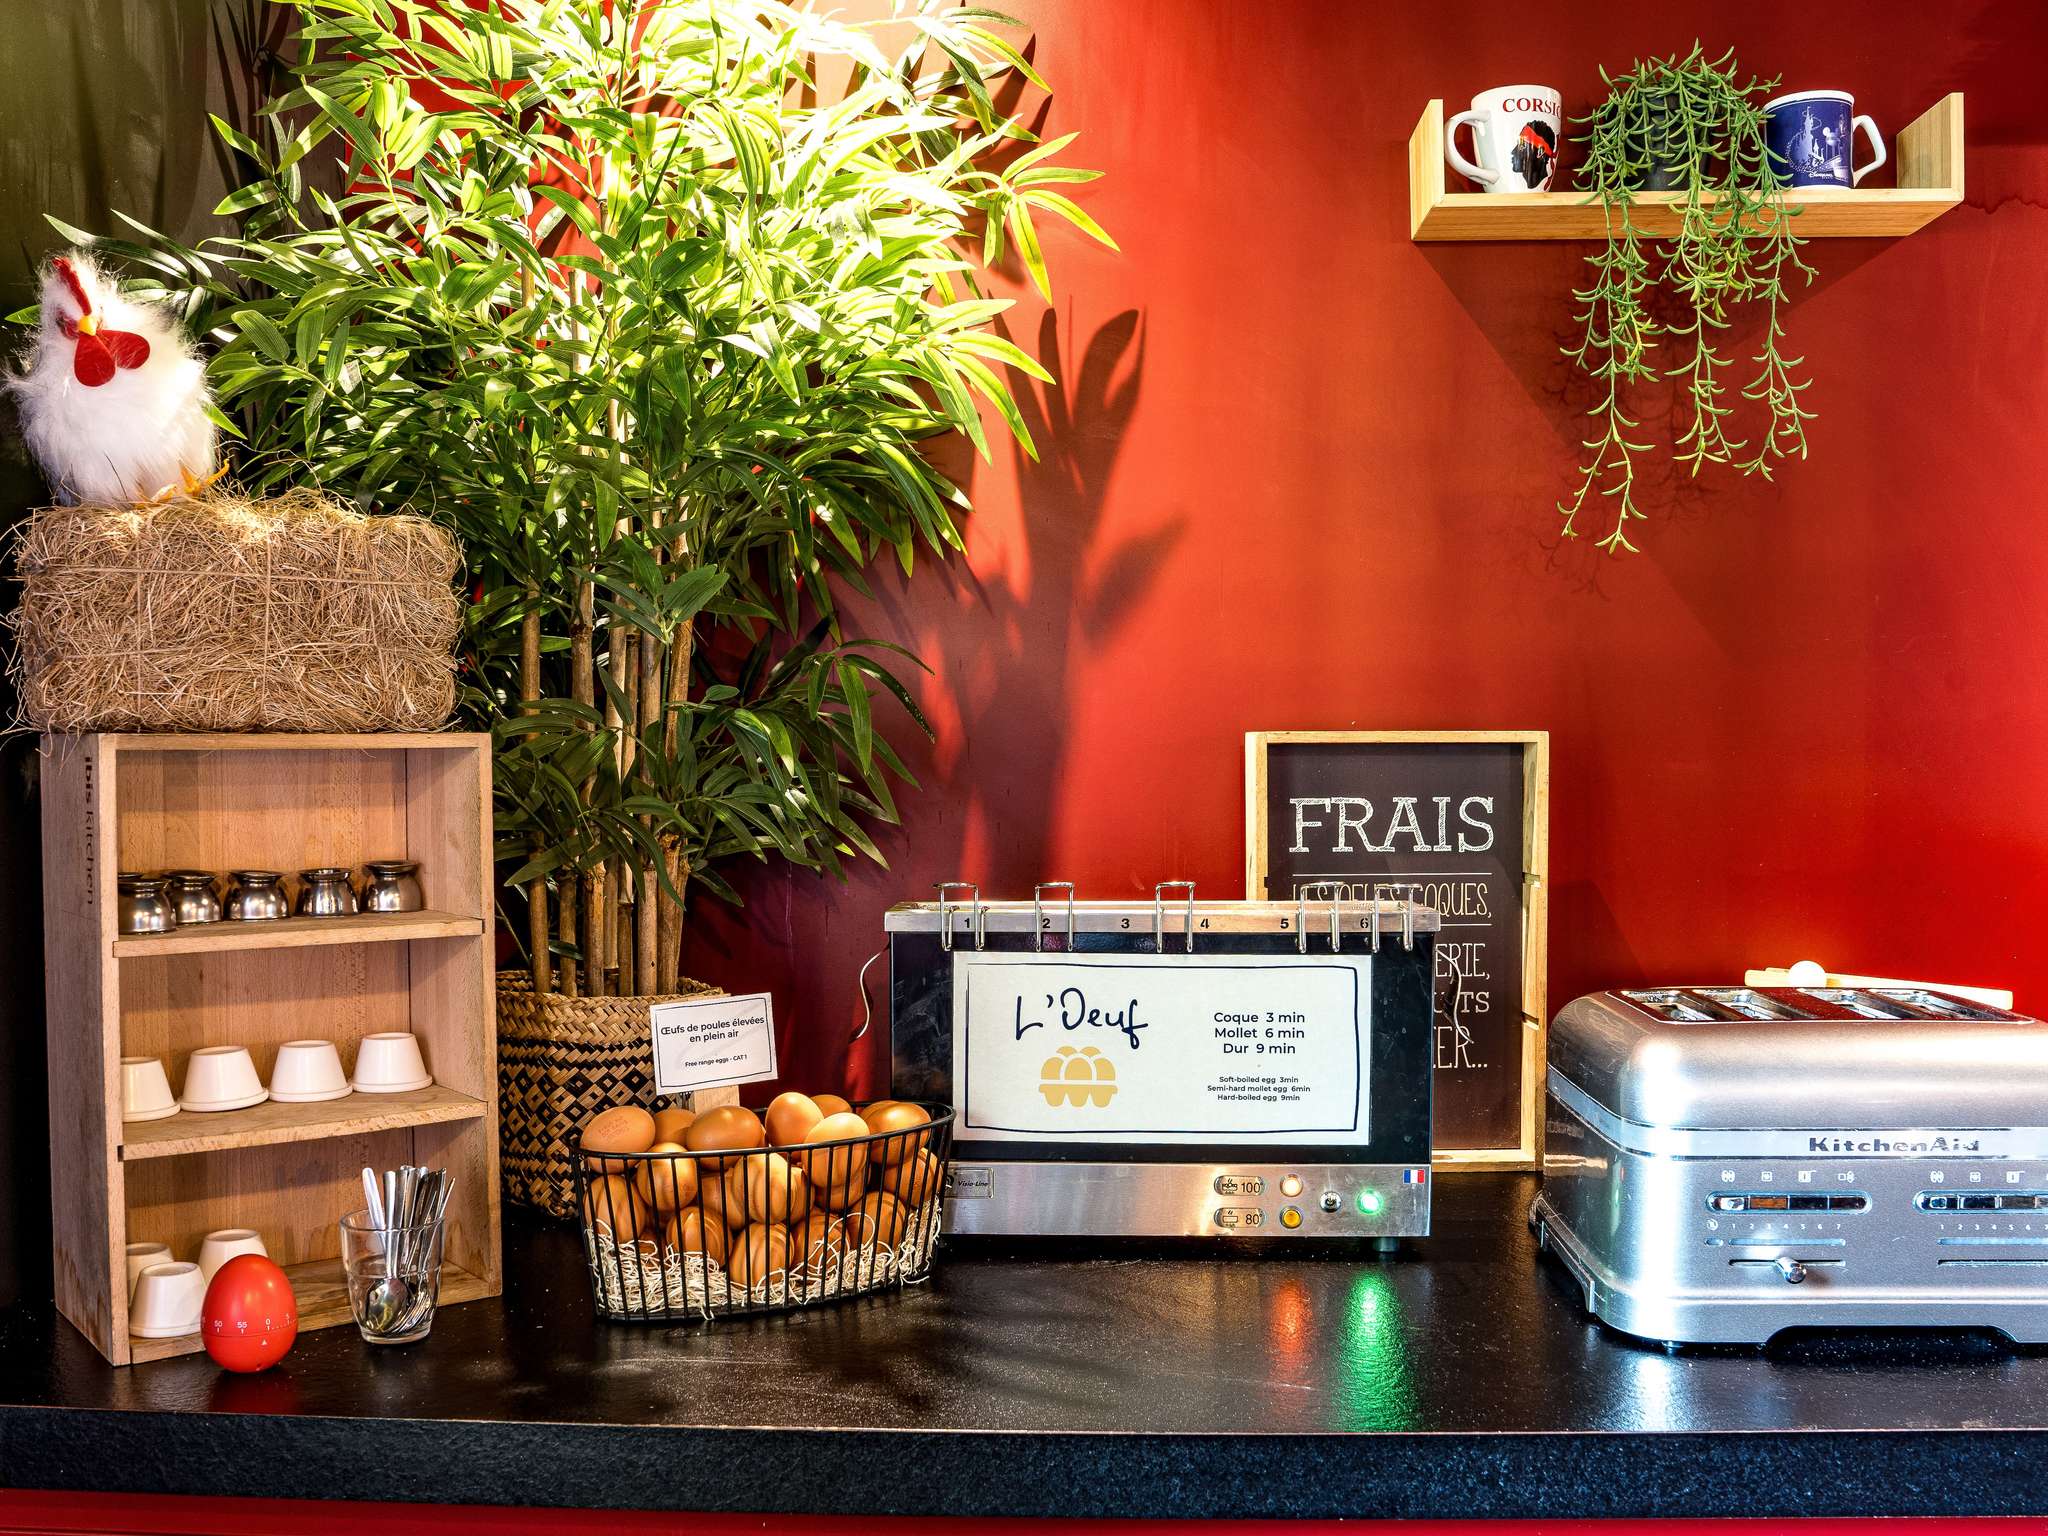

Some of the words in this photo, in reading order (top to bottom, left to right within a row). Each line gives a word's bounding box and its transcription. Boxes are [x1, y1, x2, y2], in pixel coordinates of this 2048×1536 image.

[1288, 796, 1494, 853] FRAIS
[86, 811, 94, 905] kitchen
[964, 918, 971, 928] 1
[1042, 918, 1051, 929] 2
[1121, 918, 1130, 929] 3
[1200, 918, 1210, 929] 4
[1280, 918, 1289, 929] 5
[1360, 918, 1369, 929] 6
[1213, 1012, 1259, 1025] Coque
[1266, 1012, 1274, 1022] 3
[1278, 1012, 1305, 1022] min
[661, 1025, 685, 1036] Œufs
[687, 1023, 699, 1032] de
[701, 1020, 731, 1032] poules
[732, 1016, 765, 1027] élevées
[1214, 1027, 1258, 1038] Mollet
[1265, 1027, 1274, 1038] 6
[1278, 1027, 1305, 1038] min
[689, 1034, 701, 1043] en
[703, 1031, 726, 1043] plein
[727, 1029, 739, 1038] air
[1223, 1043, 1249, 1053] Dur
[1256, 1043, 1265, 1053] 9
[1269, 1042, 1296, 1053] min
[1809, 1136, 1980, 1152] KitchenAid
[214, 1320, 223, 1328] 50
[237, 1321, 248, 1329] 55
